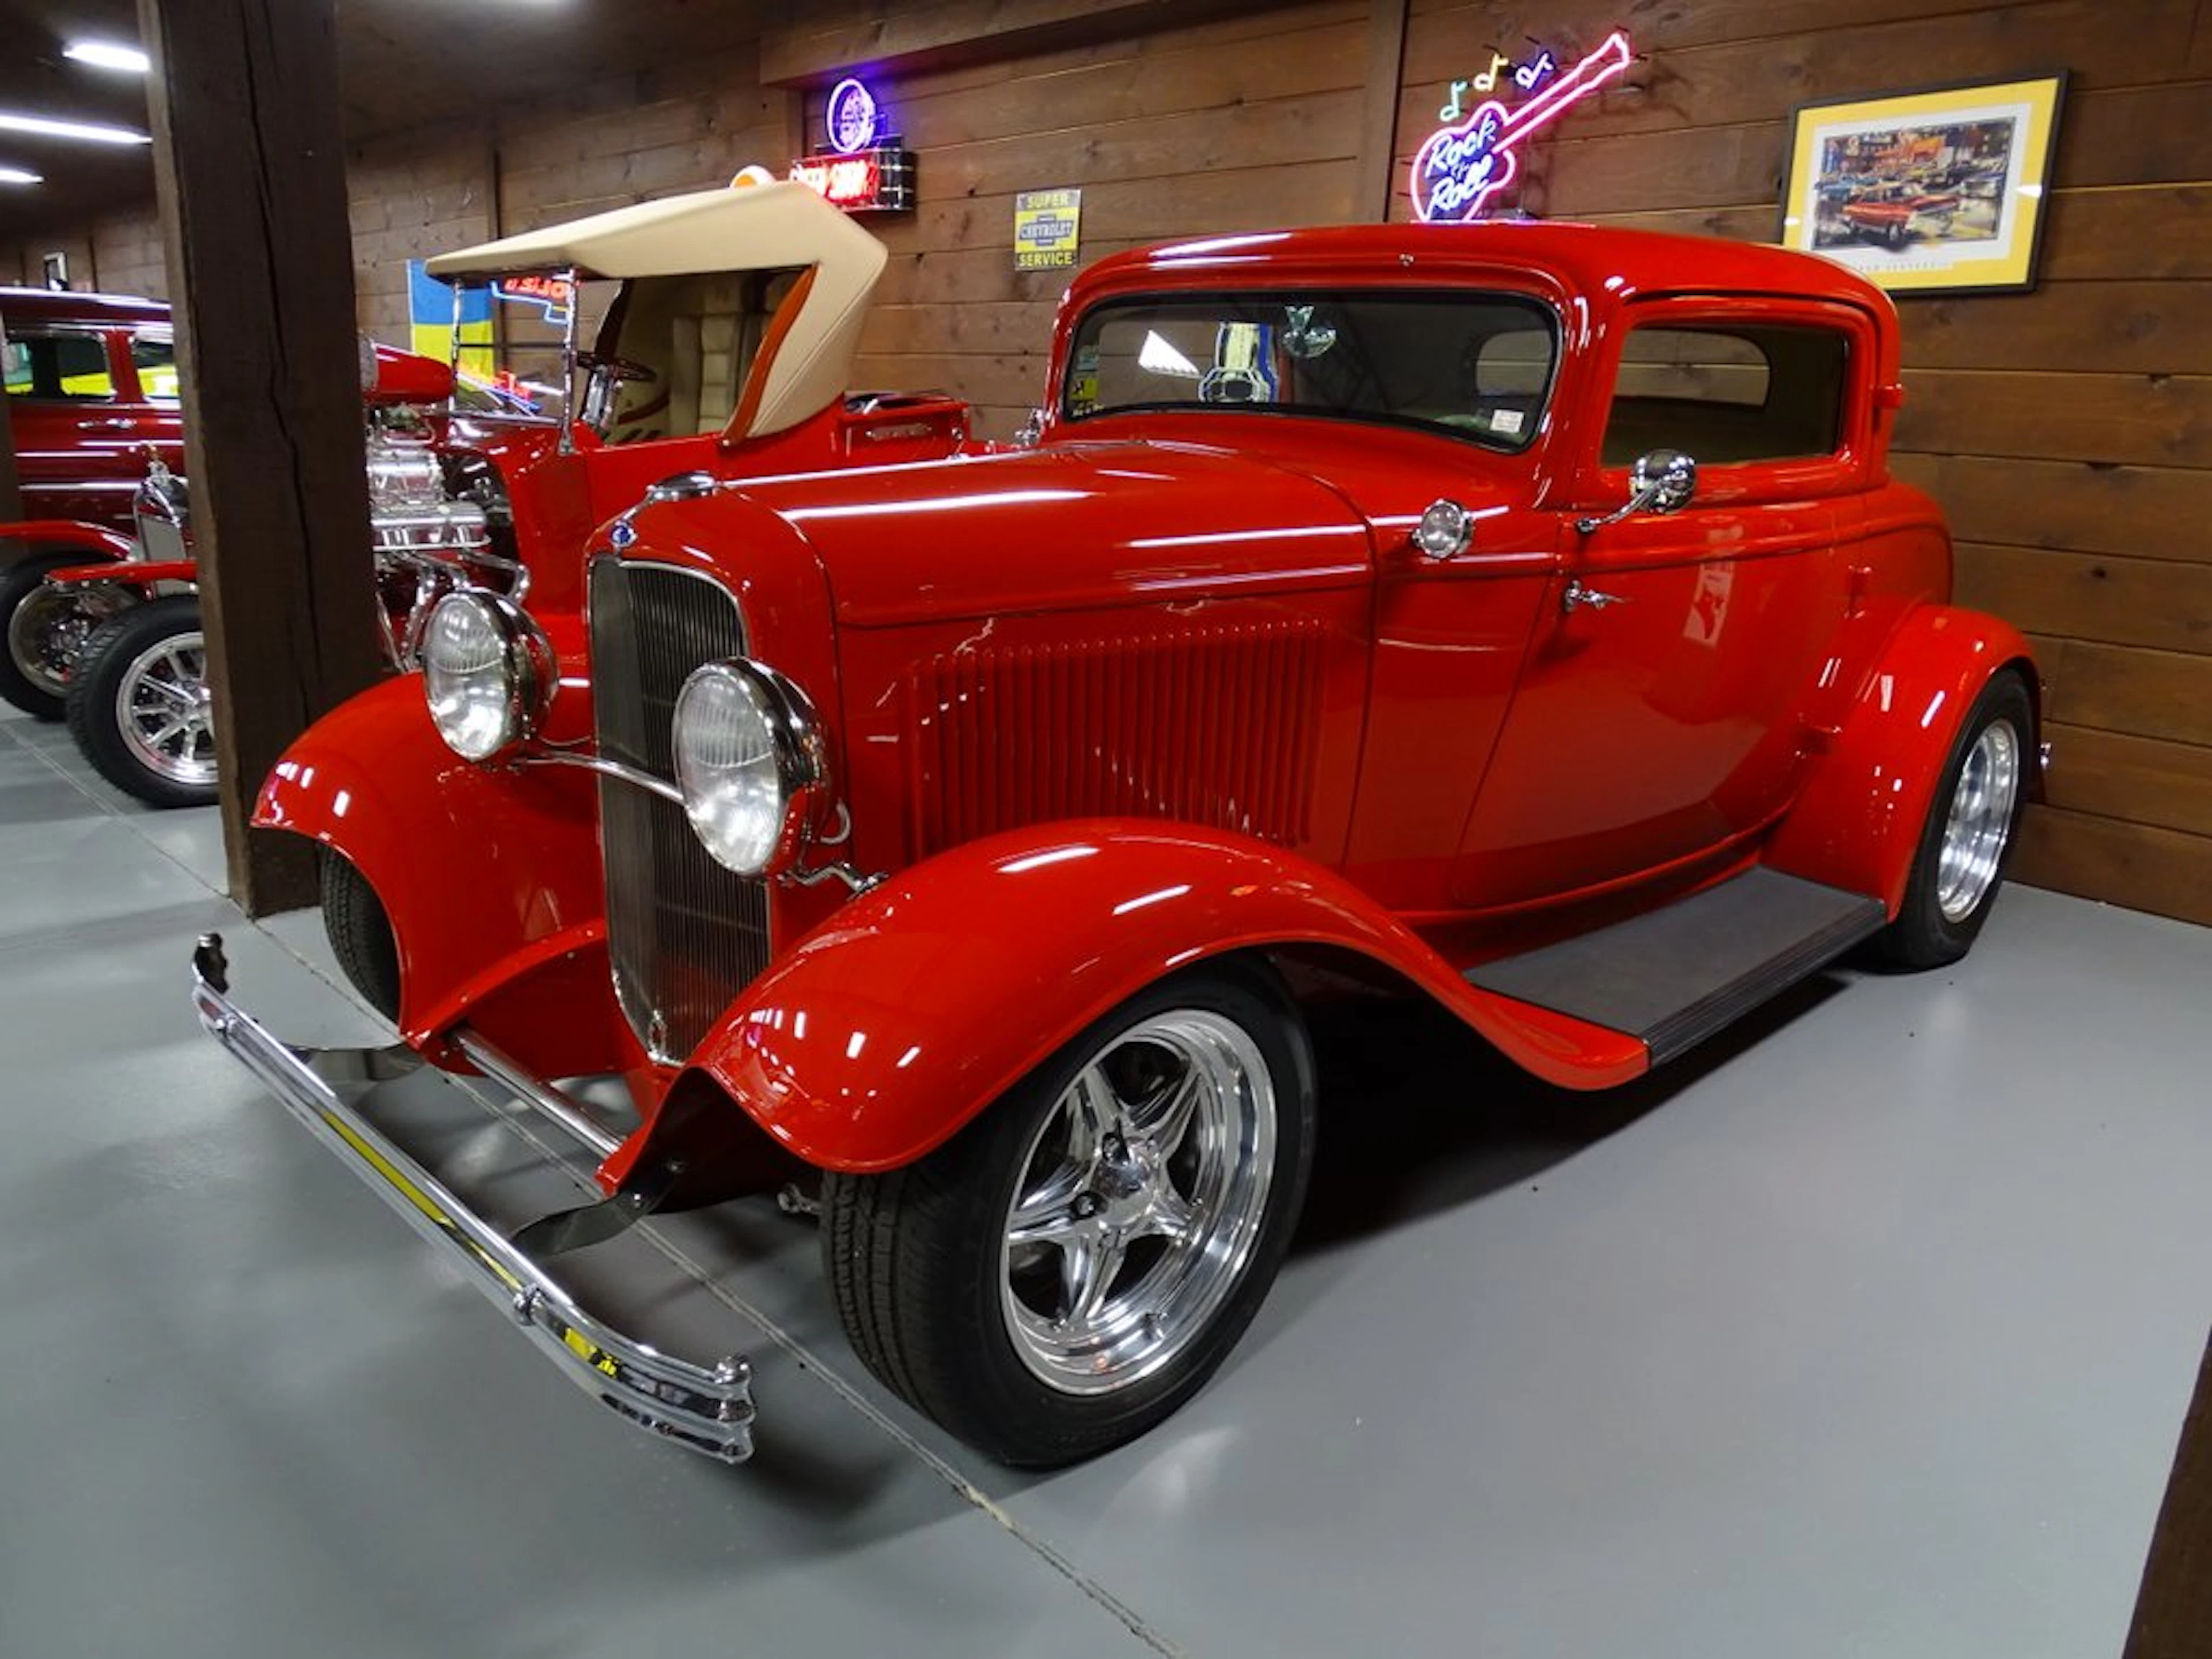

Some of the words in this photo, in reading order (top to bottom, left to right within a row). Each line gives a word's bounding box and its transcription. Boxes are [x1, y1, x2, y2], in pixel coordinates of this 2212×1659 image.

[1425, 111, 1497, 178] Rock
[1027, 193, 1069, 209] SUPER
[1425, 153, 1494, 220] Roll
[1018, 252, 1073, 267] SERVICE
